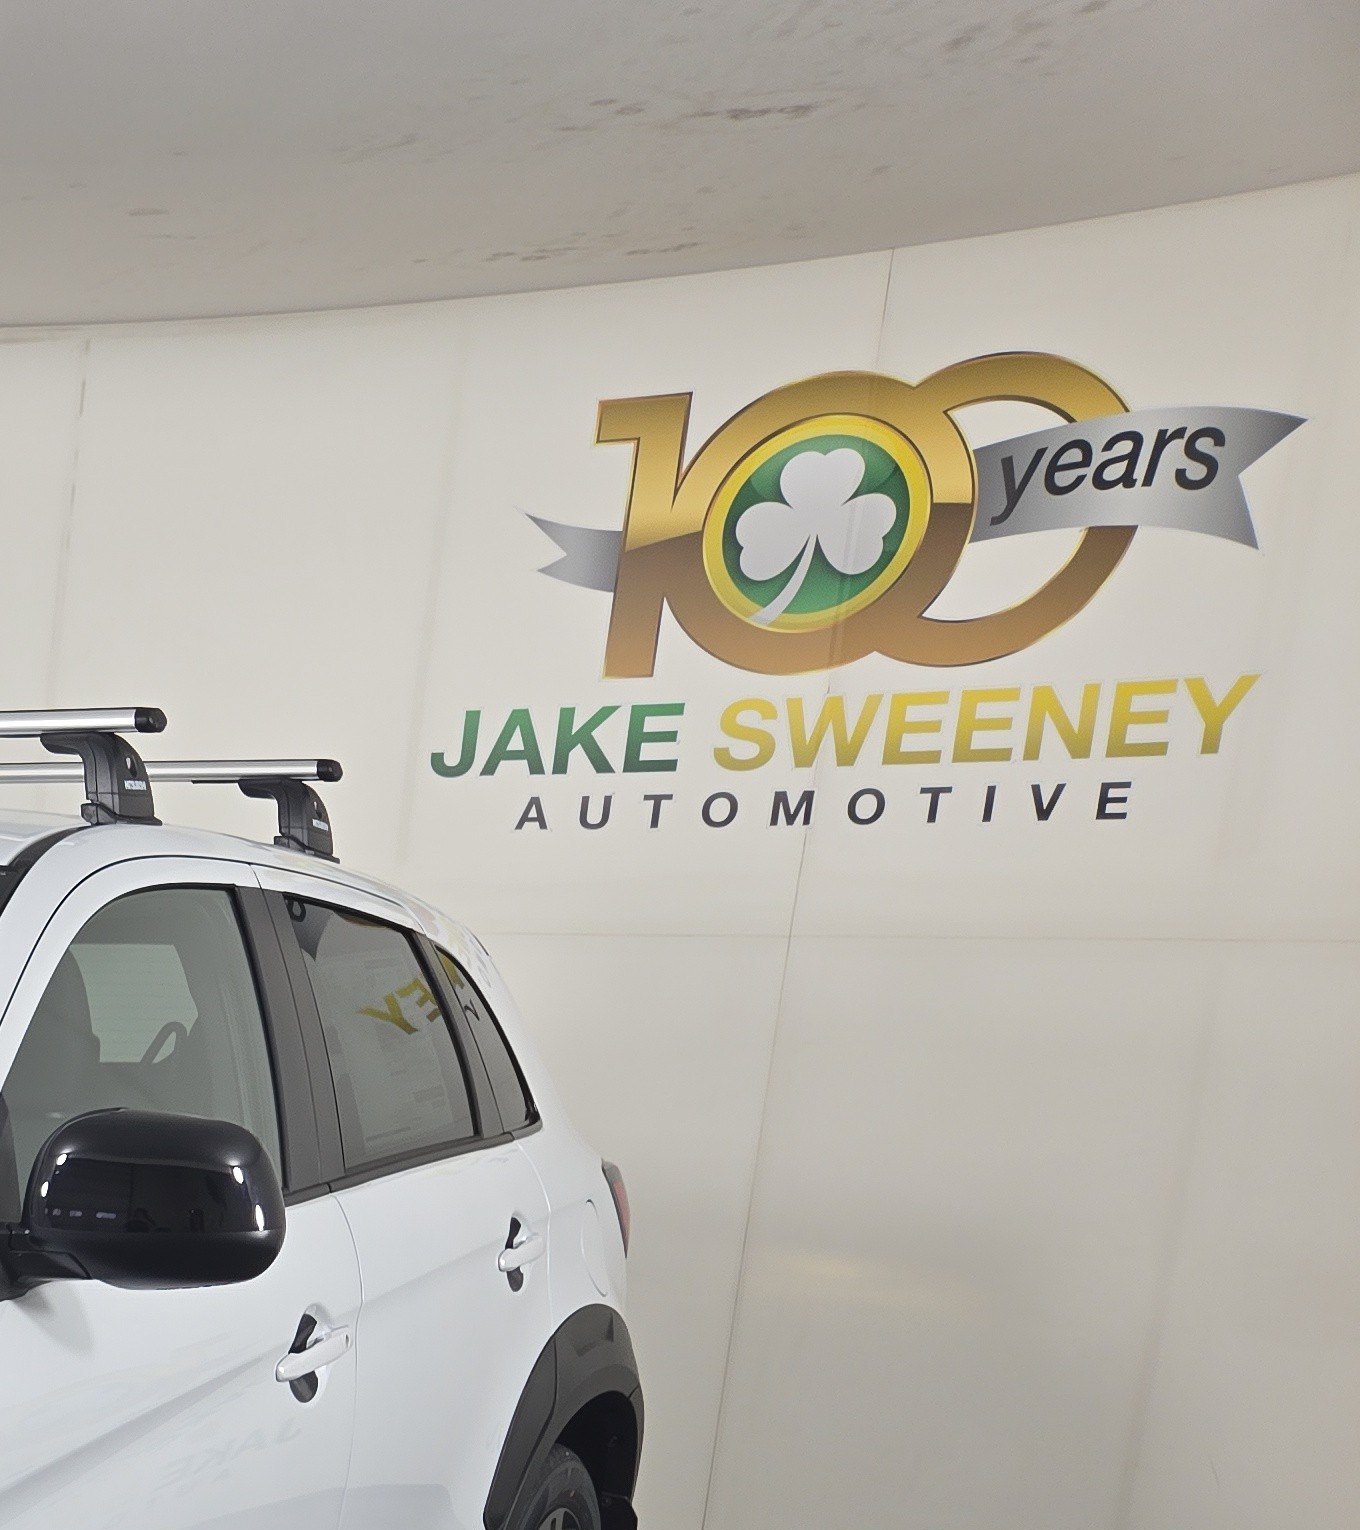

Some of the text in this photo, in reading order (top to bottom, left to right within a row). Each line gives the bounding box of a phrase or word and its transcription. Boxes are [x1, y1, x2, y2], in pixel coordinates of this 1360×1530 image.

[990, 424, 1226, 526] years
[430, 673, 1260, 778] JAKE SWEENEY
[516, 780, 1132, 832] AUTOMOTIVE
